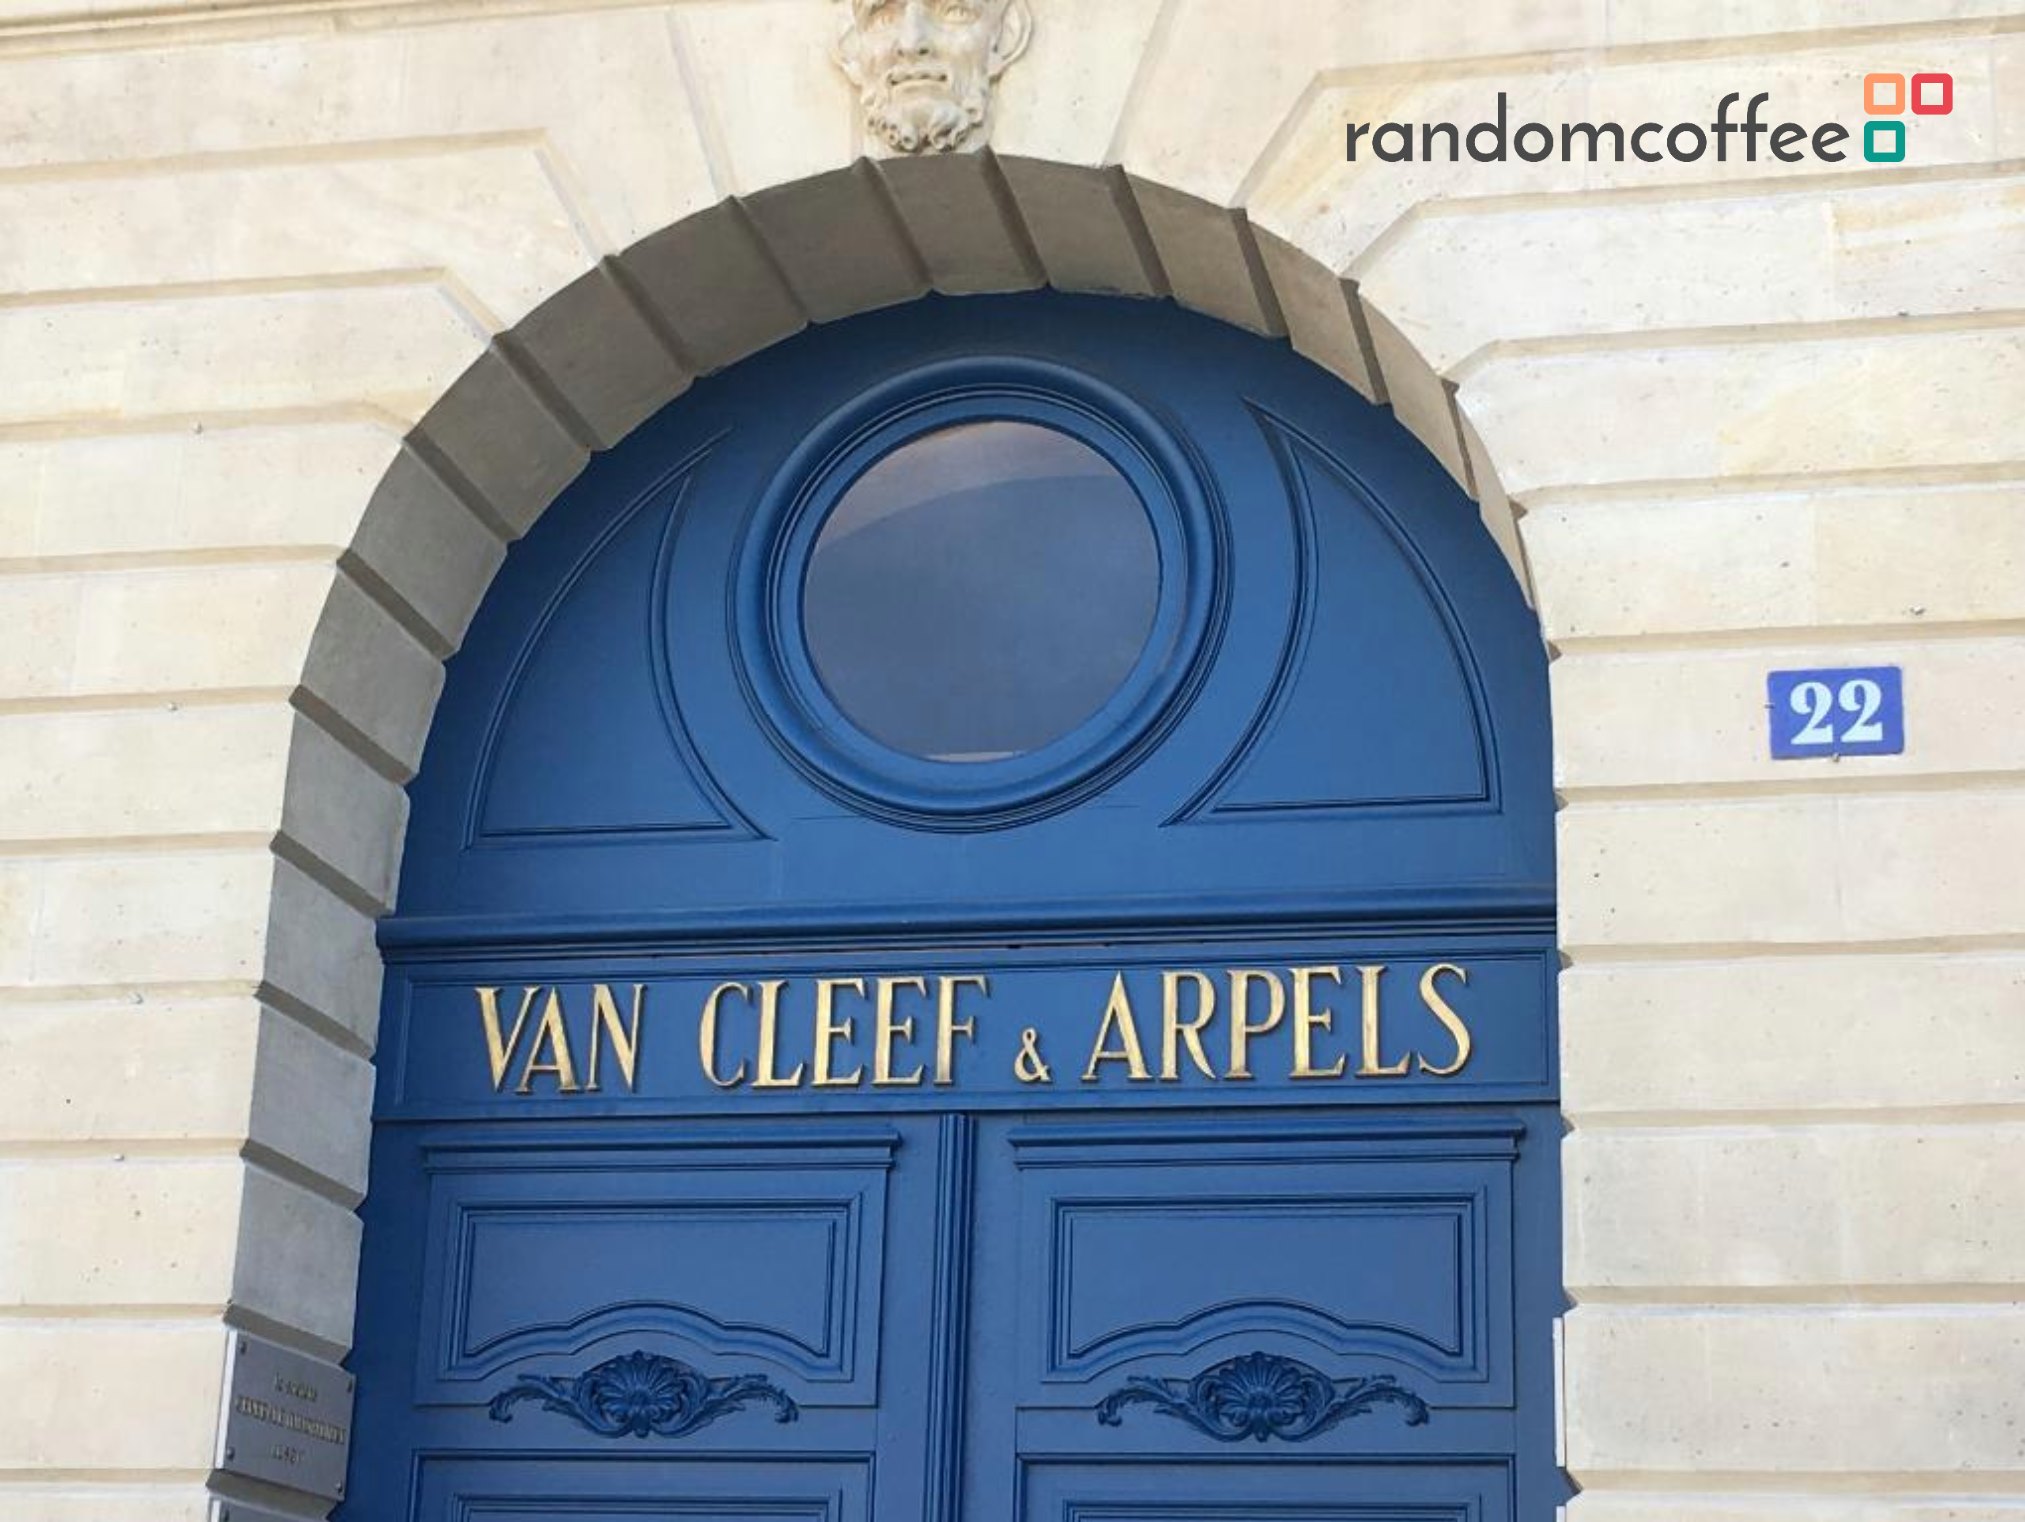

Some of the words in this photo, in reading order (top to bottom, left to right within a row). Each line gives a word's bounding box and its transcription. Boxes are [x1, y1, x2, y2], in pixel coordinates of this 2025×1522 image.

[1790, 679, 1883, 745] 22
[475, 983, 648, 1094] VAN
[699, 974, 990, 1089] CLEEF
[1013, 1027, 1052, 1083] &
[1080, 963, 1472, 1082] ARPELS
